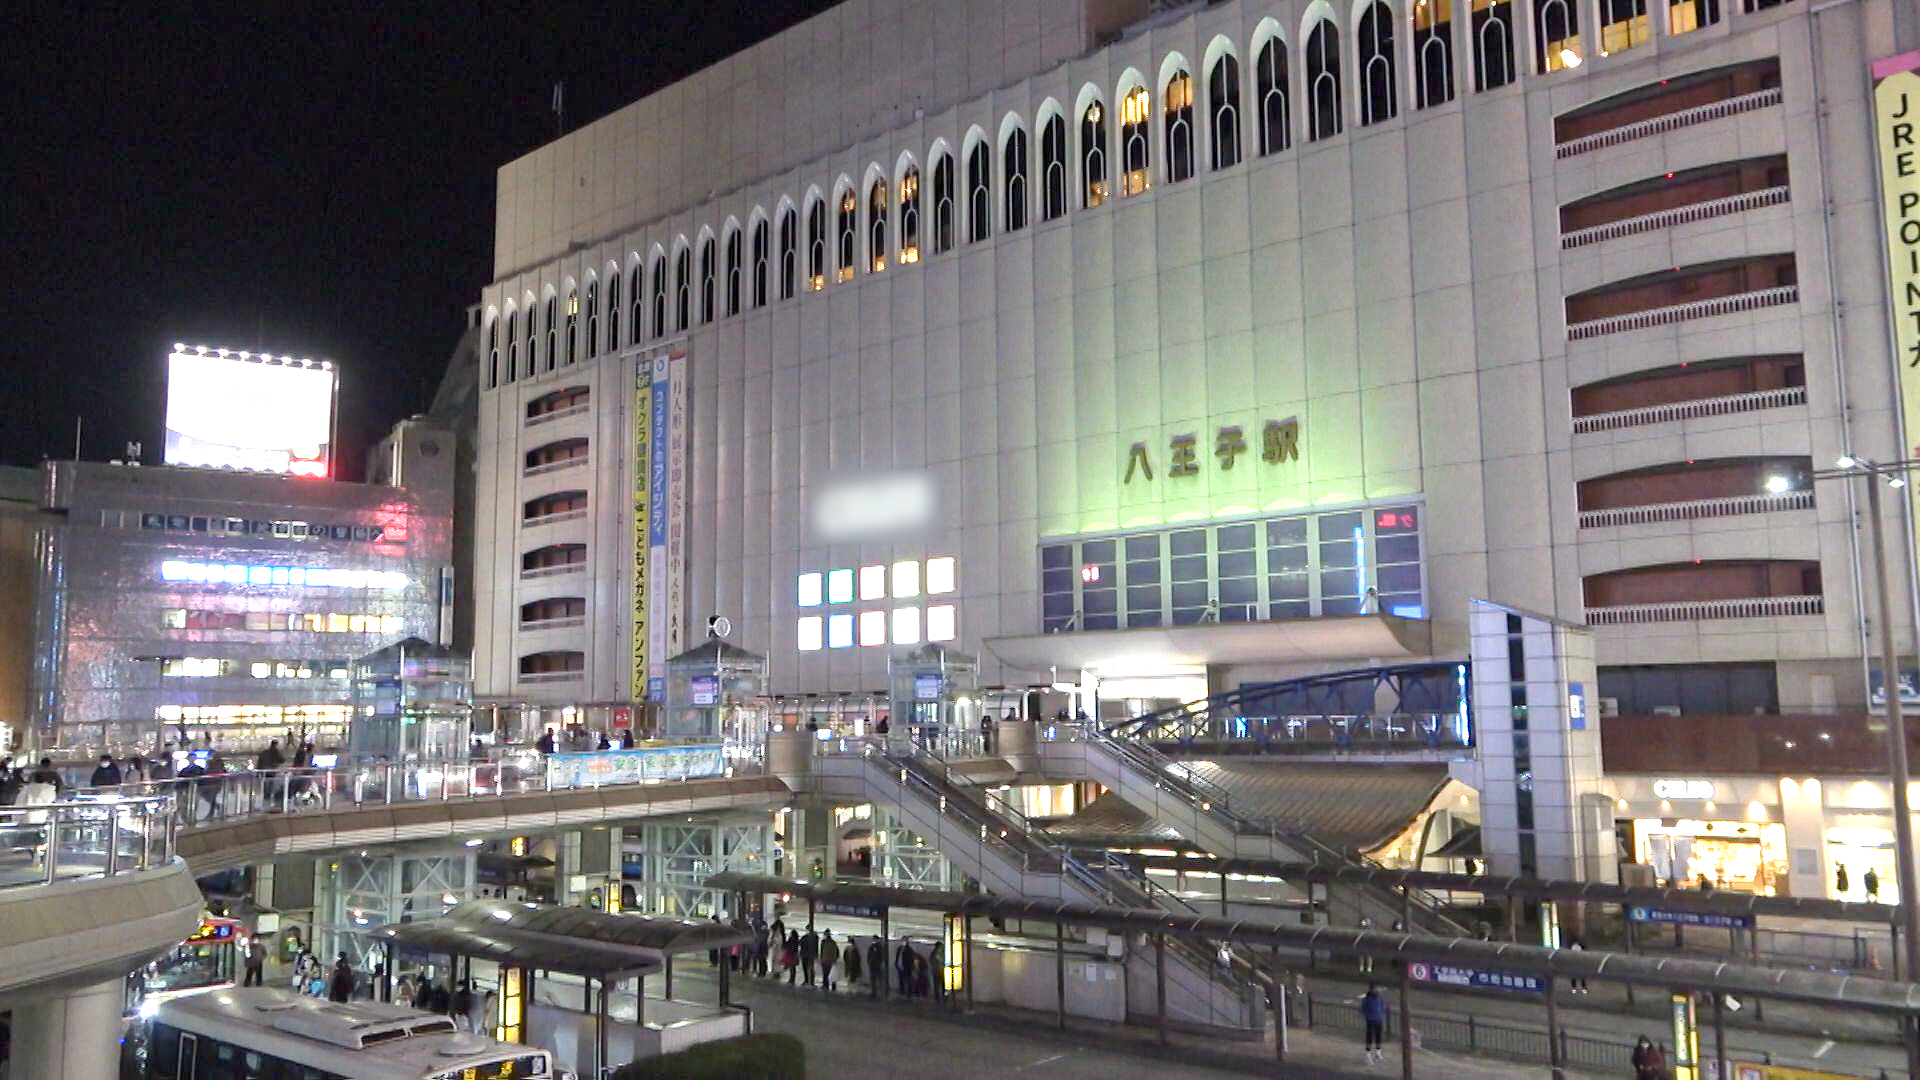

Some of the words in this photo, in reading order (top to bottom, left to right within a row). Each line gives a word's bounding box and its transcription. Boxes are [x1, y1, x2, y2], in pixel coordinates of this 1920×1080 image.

[1892, 92, 1915, 178] JRE
[1124, 415, 1299, 485] 八王子駅
